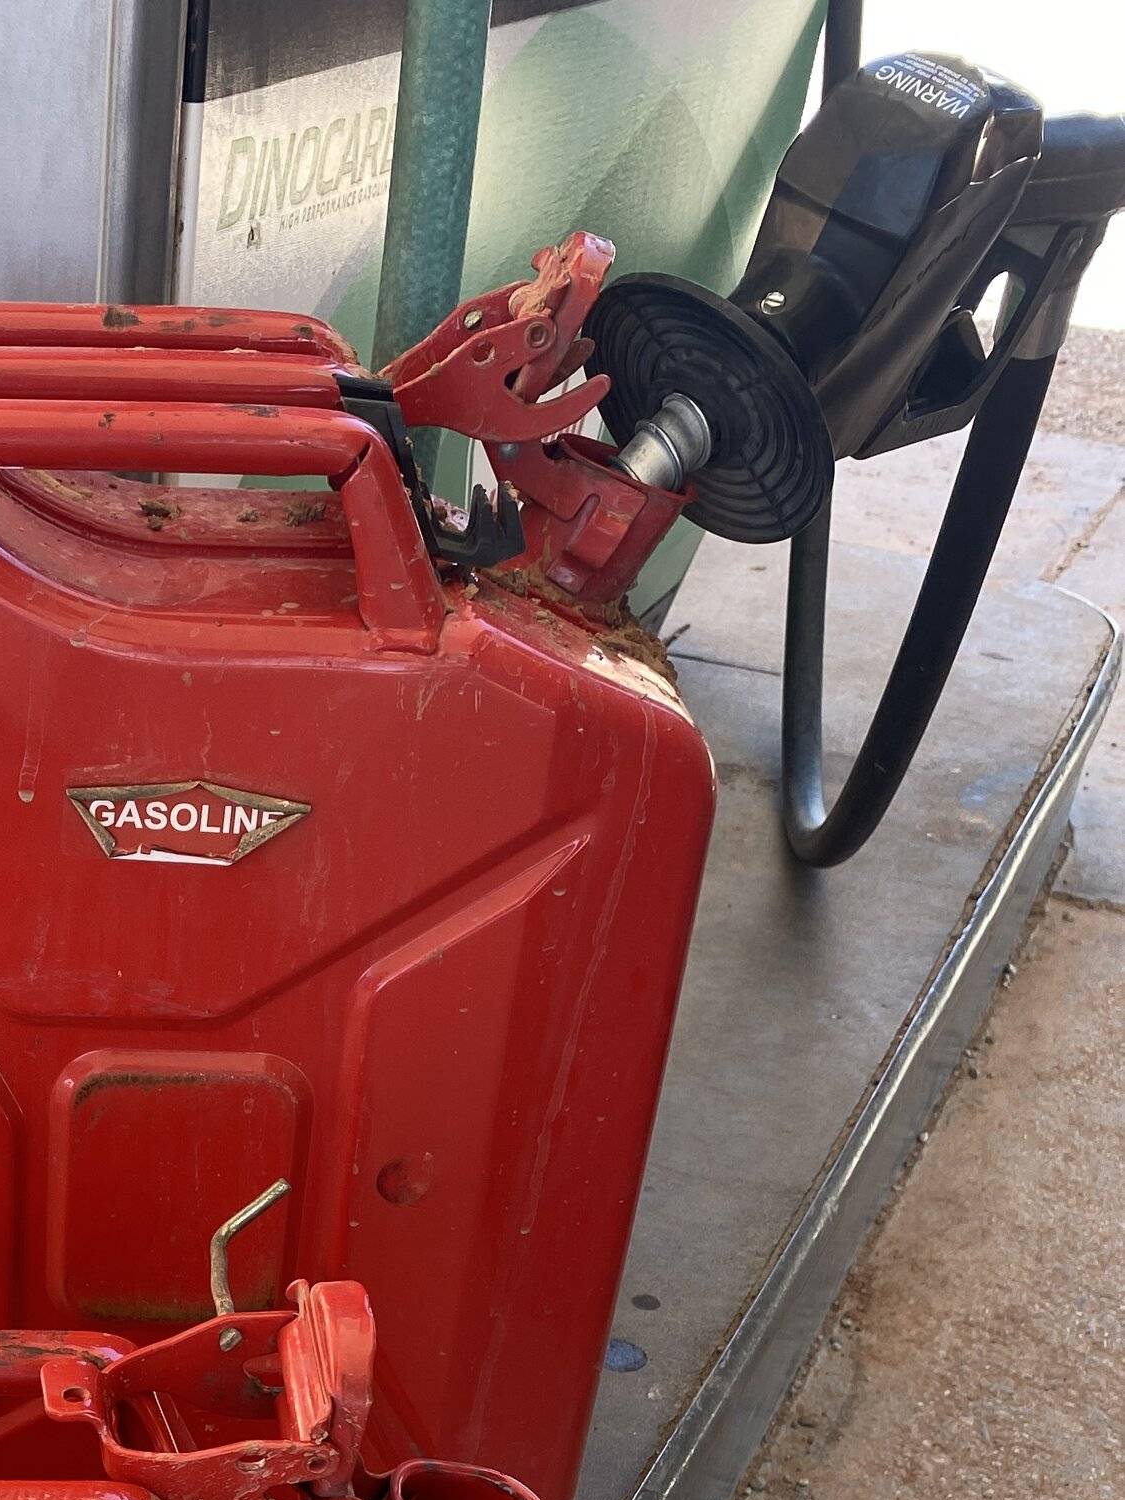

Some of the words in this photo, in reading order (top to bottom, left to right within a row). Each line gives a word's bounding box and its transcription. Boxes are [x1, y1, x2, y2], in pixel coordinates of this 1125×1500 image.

[875, 65, 971, 119] WARNING
[278, 208, 301, 232] HIGH
[301, 190, 357, 223] PERFORMANCE
